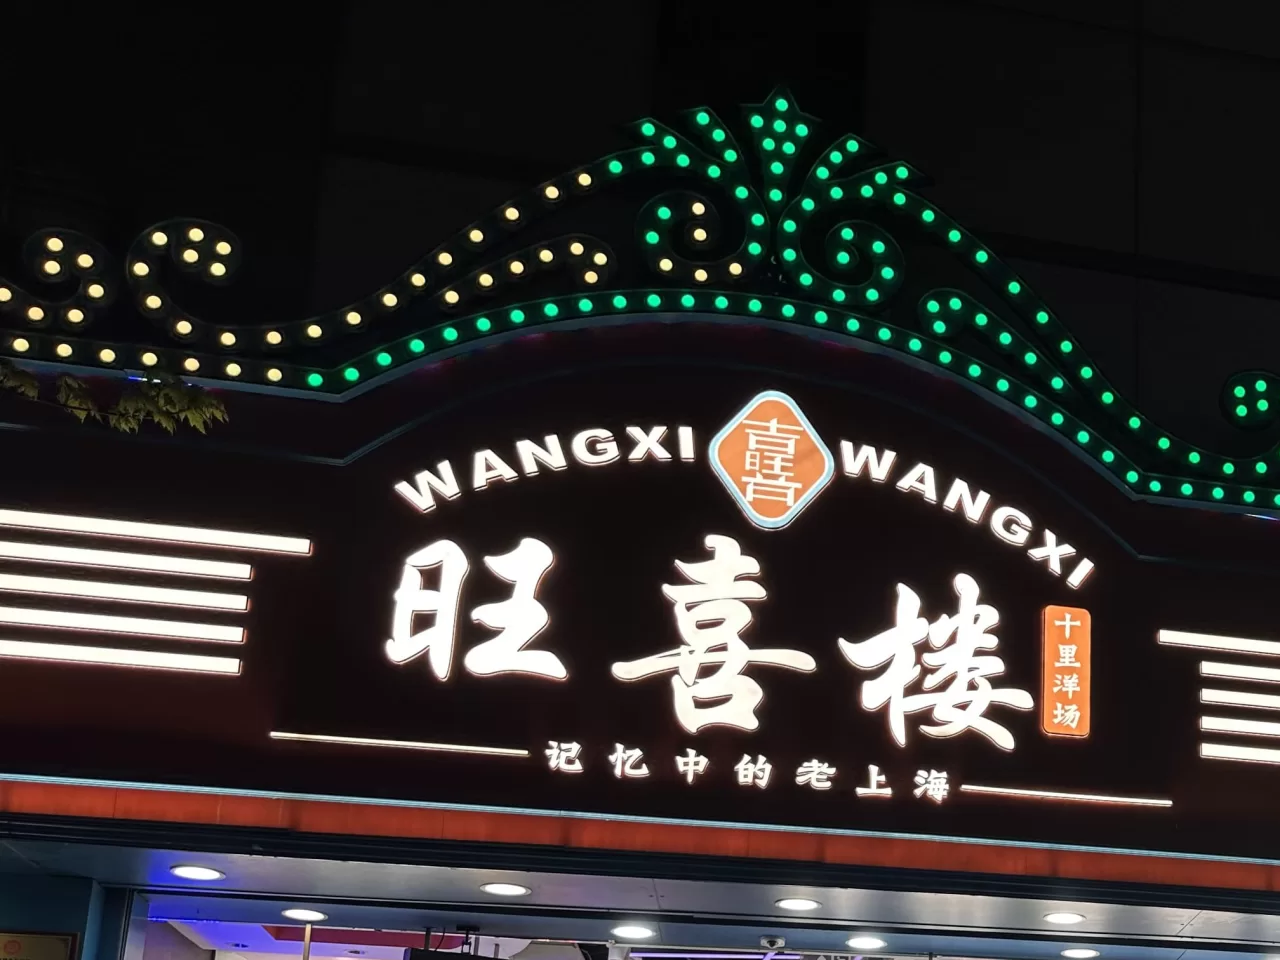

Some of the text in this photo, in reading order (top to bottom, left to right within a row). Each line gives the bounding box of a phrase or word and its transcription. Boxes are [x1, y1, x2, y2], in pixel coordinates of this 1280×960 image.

[394, 425, 695, 513] WANGXI
[839, 440, 1096, 591] WANGXI
[384, 534, 1034, 751] 旺喜楼
[1051, 612, 1082, 730] 十里洋场
[545, 740, 951, 804] 记忆中的老上海
